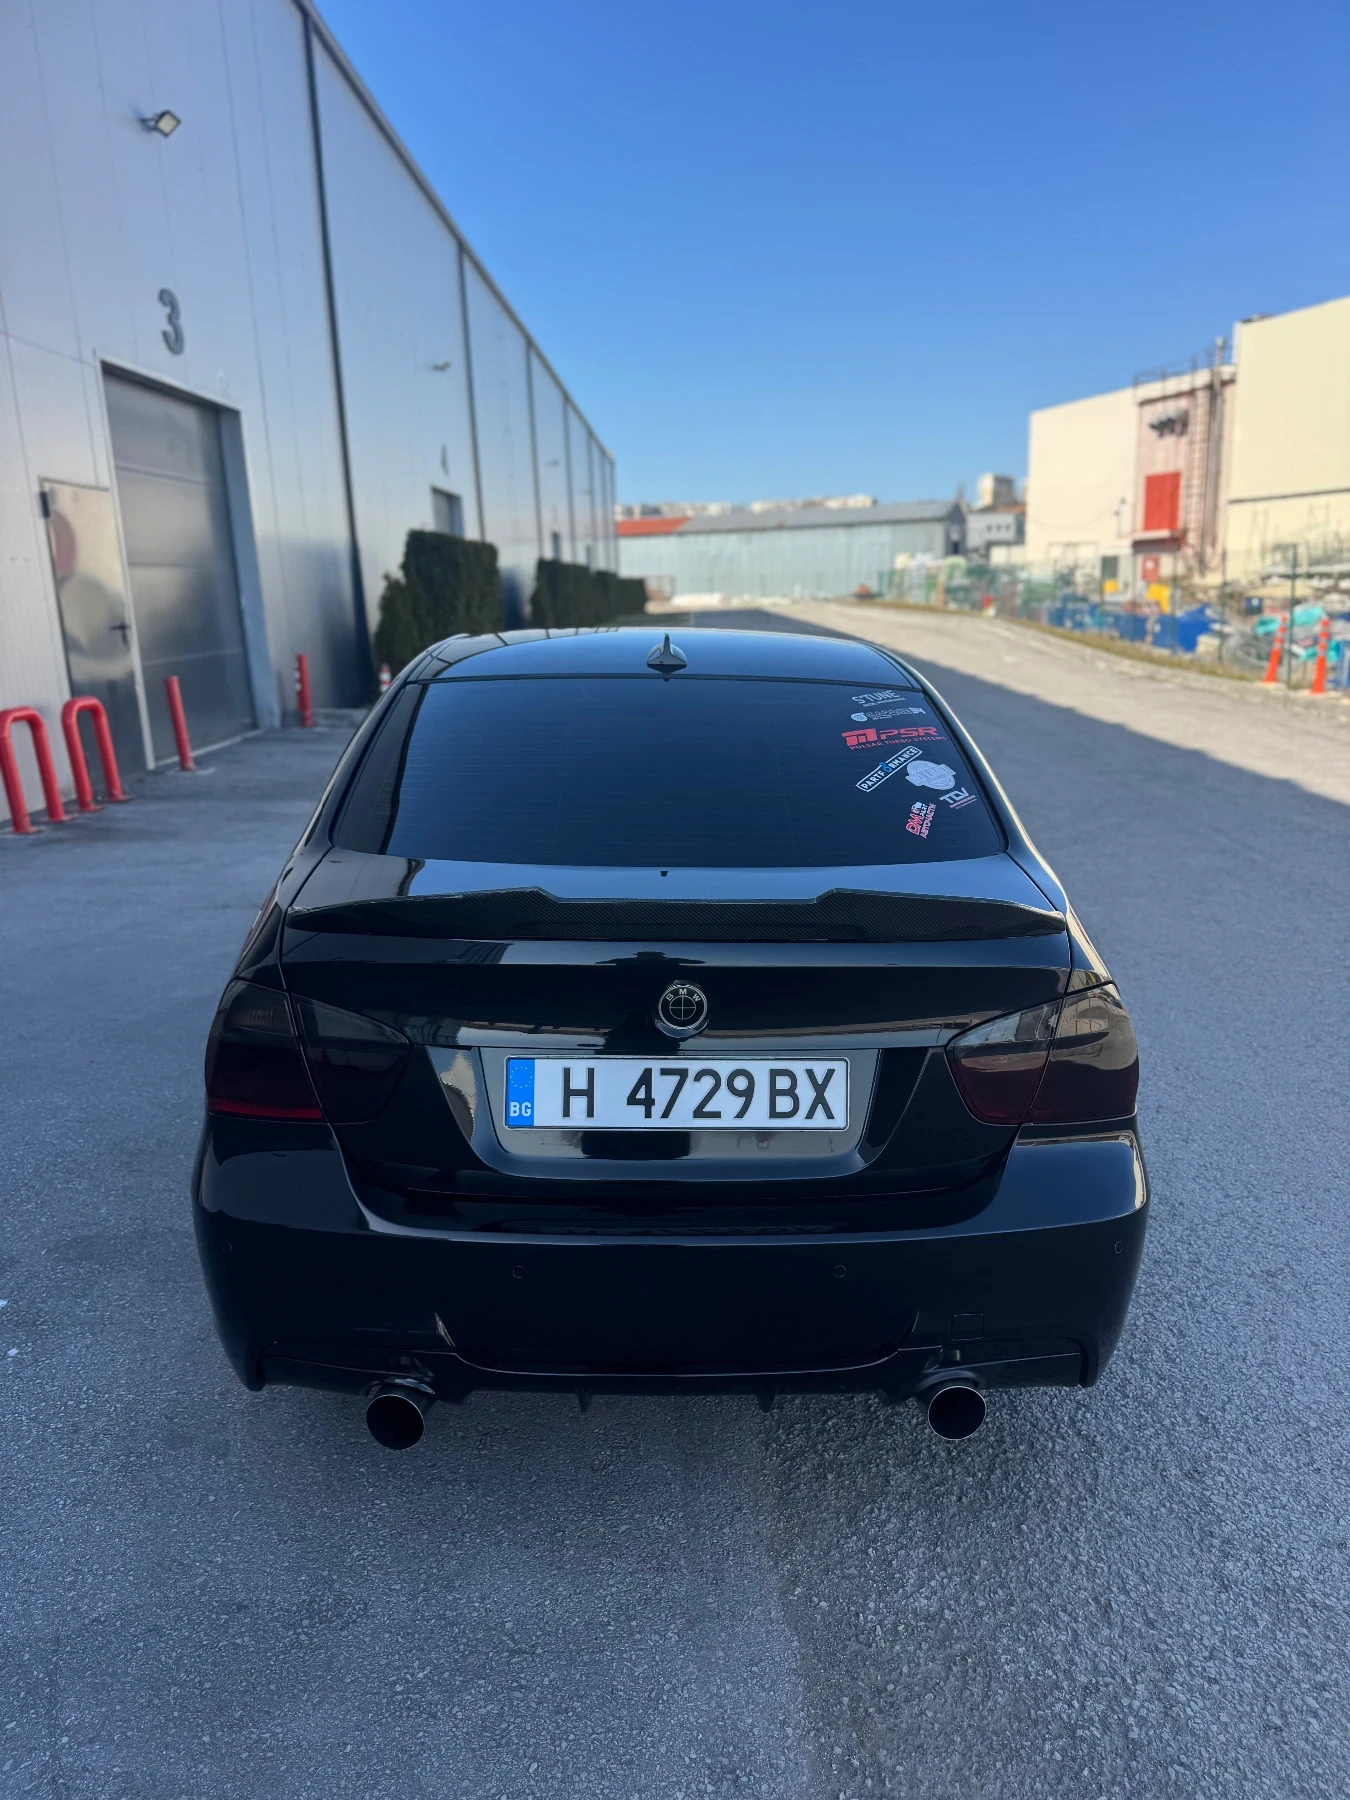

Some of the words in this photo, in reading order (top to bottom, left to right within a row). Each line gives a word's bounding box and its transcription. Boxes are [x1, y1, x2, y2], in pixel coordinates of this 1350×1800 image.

[158, 287, 185, 356] 3
[880, 727, 938, 740] PSR
[850, 740, 883, 750] PULSAR
[665, 988, 701, 1001] BMW
[562, 1067, 595, 1118] H
[626, 1067, 755, 1119] 4729
[768, 1068, 836, 1120] BX
[509, 1102, 532, 1118] BG
